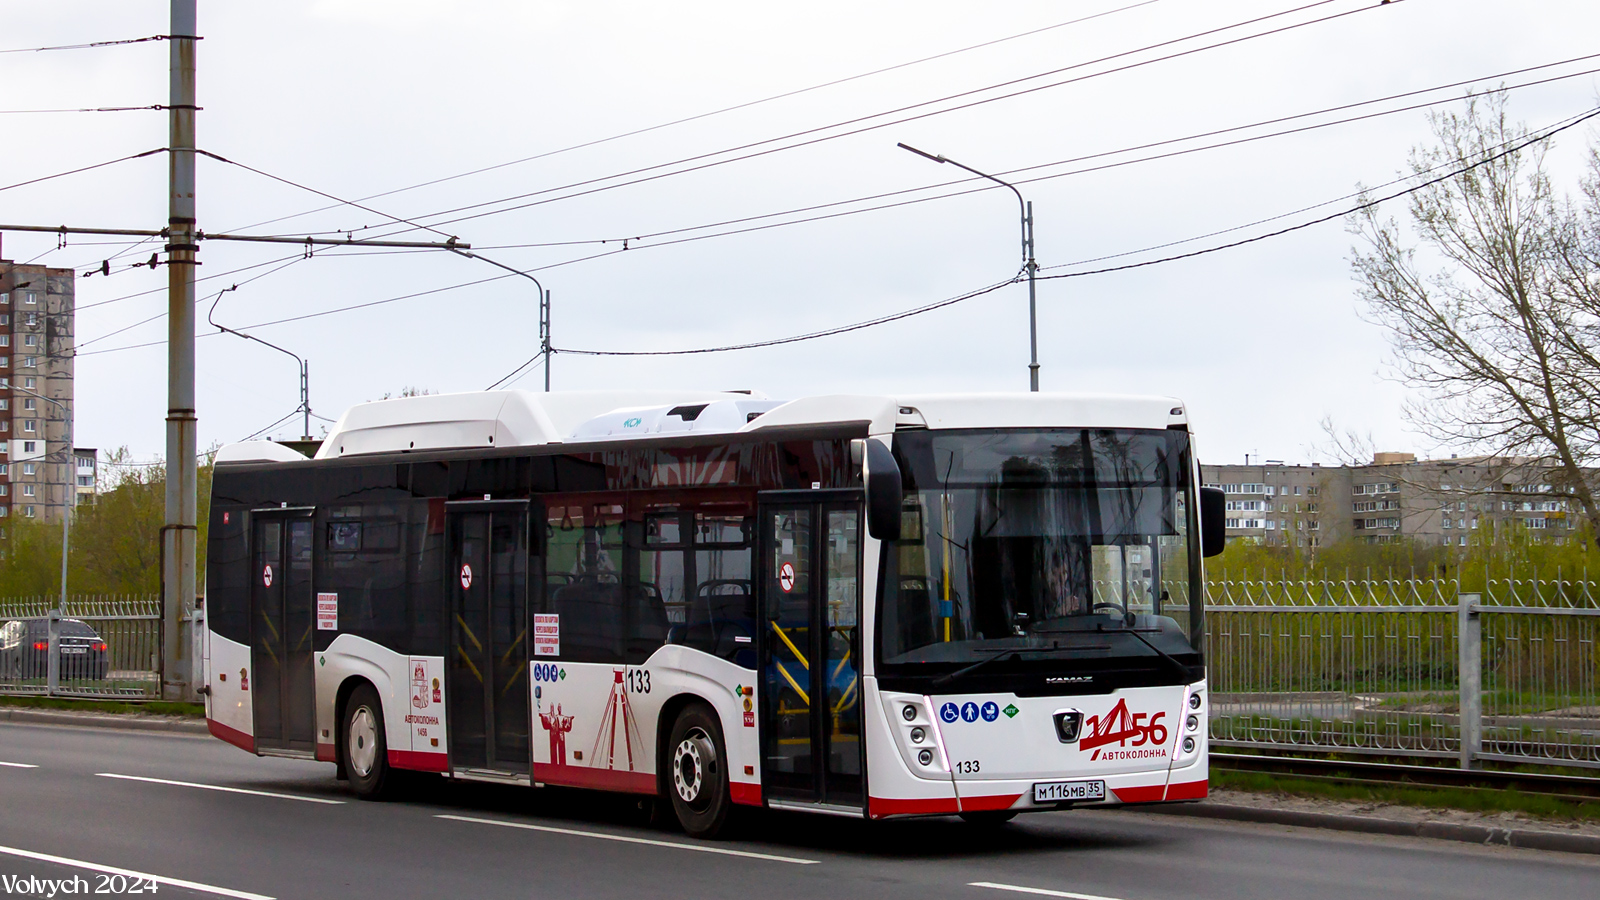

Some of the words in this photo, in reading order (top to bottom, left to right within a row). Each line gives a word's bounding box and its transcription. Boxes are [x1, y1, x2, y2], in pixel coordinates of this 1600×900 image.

[628, 669, 651, 694] 133
[405, 714, 440, 726] АВТОКОЛОННА
[1080, 698, 1168, 750] 1456
[1102, 749, 1167, 761] АВТОКОЛОННА
[956, 760, 980, 774] 133
[1088, 782, 1100, 793] 35
